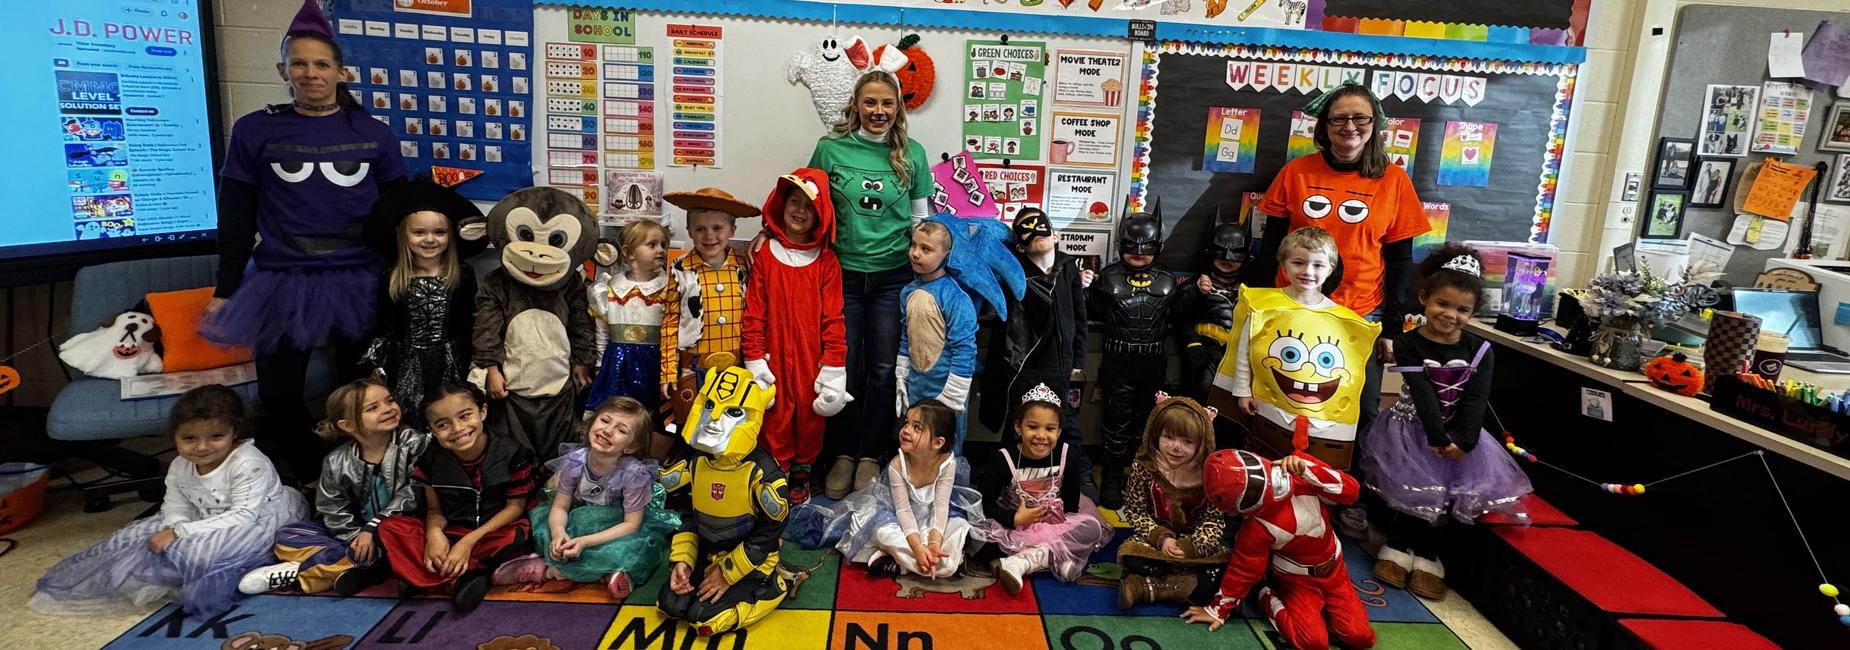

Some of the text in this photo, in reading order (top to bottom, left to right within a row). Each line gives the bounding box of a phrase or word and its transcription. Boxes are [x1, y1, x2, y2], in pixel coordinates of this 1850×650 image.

[573, 8, 629, 22] DAYS IN
[50, 18, 192, 45] J.D. POWER
[574, 24, 632, 37] SCHOOL
[582, 48, 594, 57] 10
[638, 51, 652, 59] 110
[977, 48, 1034, 59] GREEN CHOICES
[1060, 55, 1121, 66] MOVIE THEATER
[582, 66, 595, 75] 20
[1079, 67, 1101, 76] MODE
[1229, 64, 1480, 99] WEEKLY FOCUS
[72, 91, 115, 101] LEVEL
[59, 102, 107, 110] SOLUTION
[582, 102, 595, 111] 40
[1221, 107, 1248, 116] Letter
[1061, 118, 1111, 127] COFFEE SHOP
[1385, 117, 1405, 125] olor
[1224, 123, 1239, 135] Dd
[1459, 121, 1484, 133] Shape
[1074, 129, 1096, 137] MODE
[582, 138, 595, 146] 60
[1221, 146, 1235, 160] Gg
[583, 154, 596, 163] 70
[985, 170, 1030, 181] RED CHOICES
[1057, 174, 1107, 184] RESTAURANT
[1071, 185, 1092, 193] MODE
[584, 191, 597, 200] 90
[1423, 202, 1449, 210] Words
[1060, 233, 1095, 242] STADIUM
[1736, 394, 1775, 420] Mrs.
[844, 622, 934, 650] Nn
[1060, 626, 1162, 650] Oo
